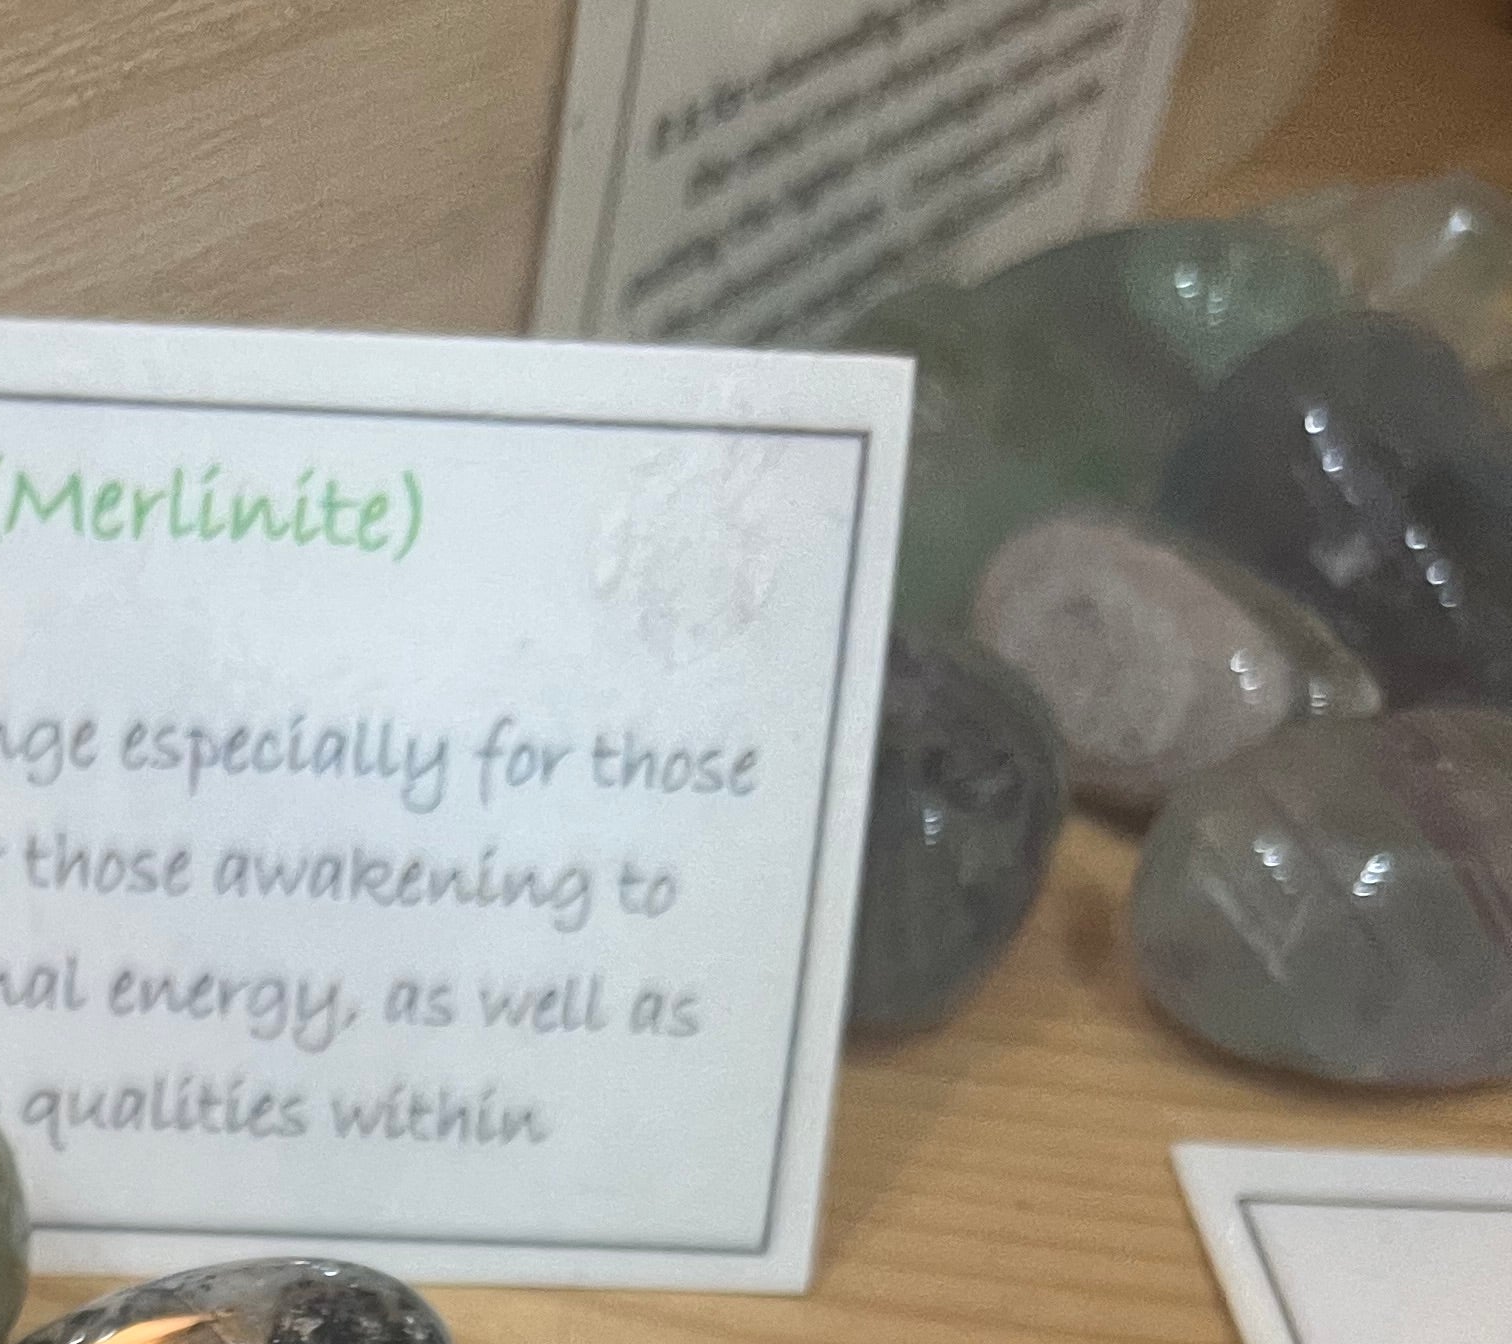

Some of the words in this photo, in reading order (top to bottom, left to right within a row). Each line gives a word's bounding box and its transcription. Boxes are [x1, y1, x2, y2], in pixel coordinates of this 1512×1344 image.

[120, 713, 450, 813] especially
[475, 715, 573, 803] for
[591, 731, 759, 797] those
[23, 831, 191, 896] those
[214, 846, 593, 932] awakening
[617, 861, 677, 917] to
[108, 967, 357, 1052] energy,
[385, 978, 455, 1026] as
[480, 976, 605, 1033] well
[629, 988, 699, 1037] as
[21, 1076, 308, 1151] qualities
[331, 1084, 547, 1144] within
